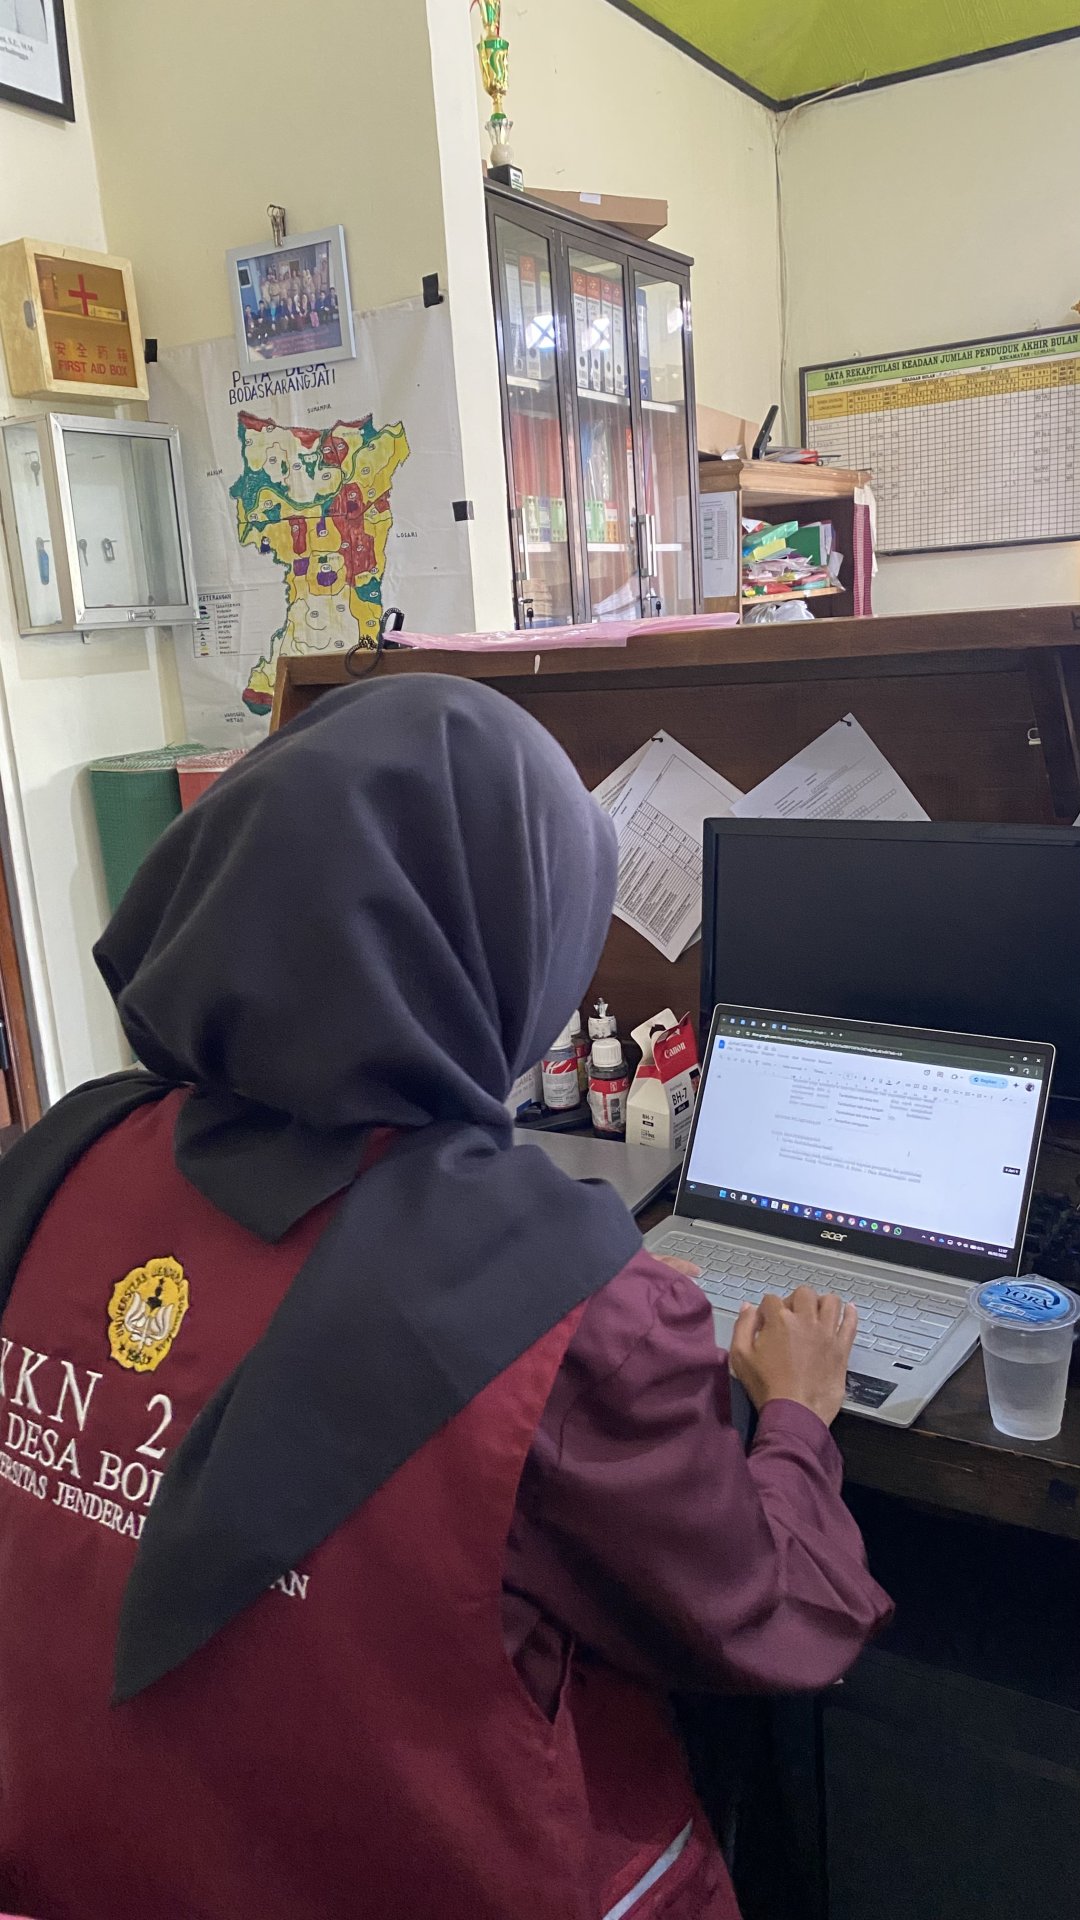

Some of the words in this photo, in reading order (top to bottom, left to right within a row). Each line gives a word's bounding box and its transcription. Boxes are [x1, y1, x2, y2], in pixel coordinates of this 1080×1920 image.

[58, 360, 87, 374] FIRST
[91, 363, 107, 375] AID
[110, 364, 128, 377] BOX
[824, 370, 844, 382] DATA
[846, 362, 900, 378] REKAPITULASI
[902, 356, 938, 370] KEADAAN
[940, 350, 973, 363] JUMLAH
[975, 344, 1019, 359] PENDUDUK
[1021, 338, 1049, 352] AKHIR
[1050, 334, 1079, 347] BULAN
[228, 368, 336, 405] BODASKARANGJATI
[664, 1042, 686, 1059] Canon
[671, 1088, 688, 1105] BH-7
[820, 1230, 848, 1242] acer
[136, 1394, 172, 1459] 2
[5, 1412, 81, 1479] DESA
